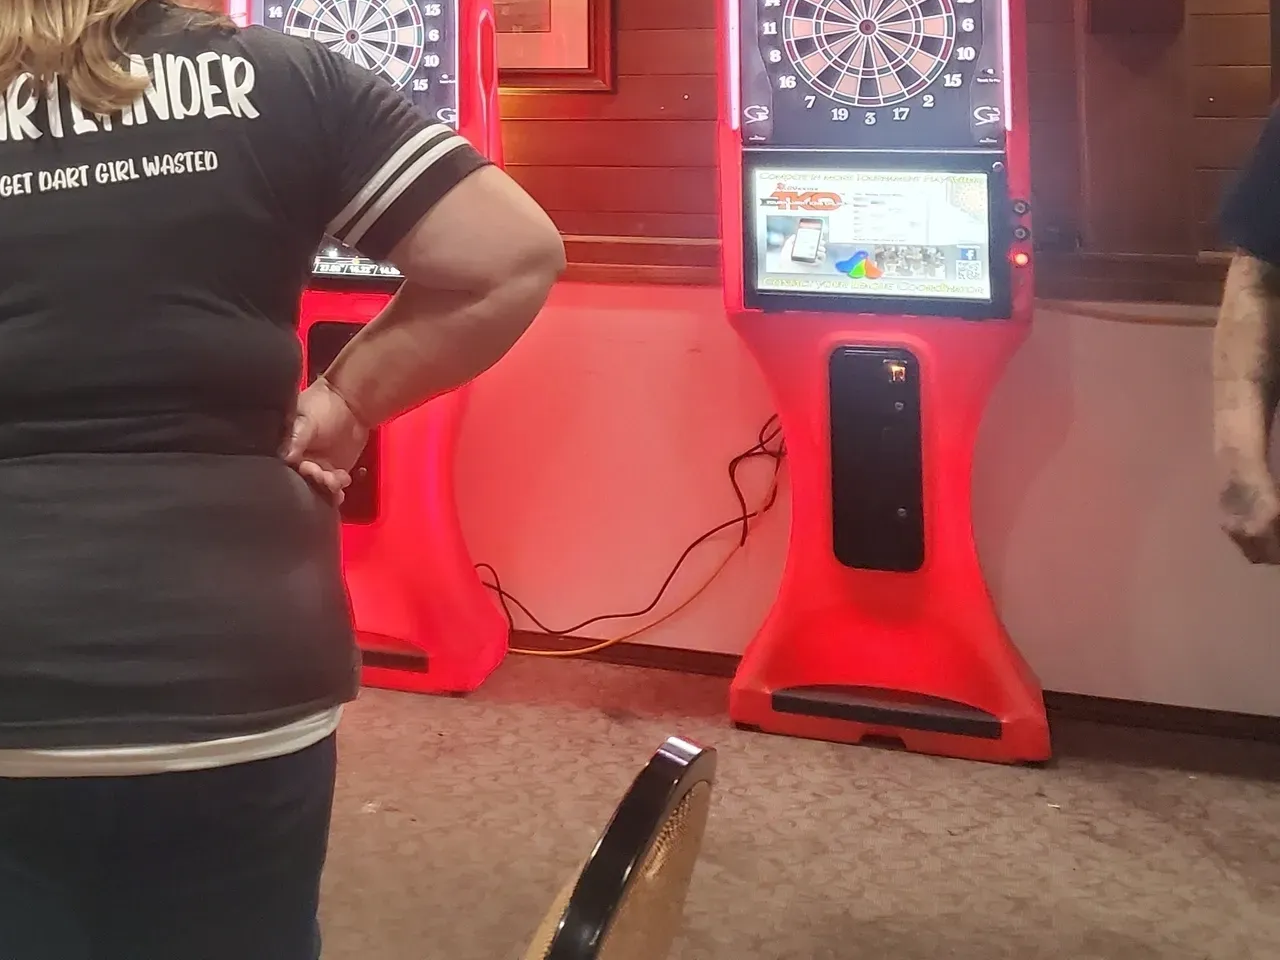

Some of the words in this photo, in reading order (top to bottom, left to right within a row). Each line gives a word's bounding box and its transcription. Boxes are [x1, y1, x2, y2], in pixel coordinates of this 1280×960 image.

[268, 6, 282, 18] 14
[425, 4, 441, 16] 13
[763, 22, 777, 35] 11
[962, 18, 974, 32] 6
[429, 30, 439, 41] 6
[769, 49, 781, 63] 8
[957, 47, 975, 61] 10
[424, 55, 439, 67] 10
[413, 79, 428, 91] 15
[779, 76, 796, 89] 16
[943, 74, 962, 87] 15
[804, 96, 816, 109] 7
[923, 95, 935, 108] 2
[831, 108, 849, 122] 19
[865, 112, 876, 125] 3
[892, 108, 910, 121] 17
[0, 171, 33, 197] GET
[39, 164, 90, 192] DART
[95, 158, 139, 185] GIRL
[143, 149, 219, 177] WASTED
